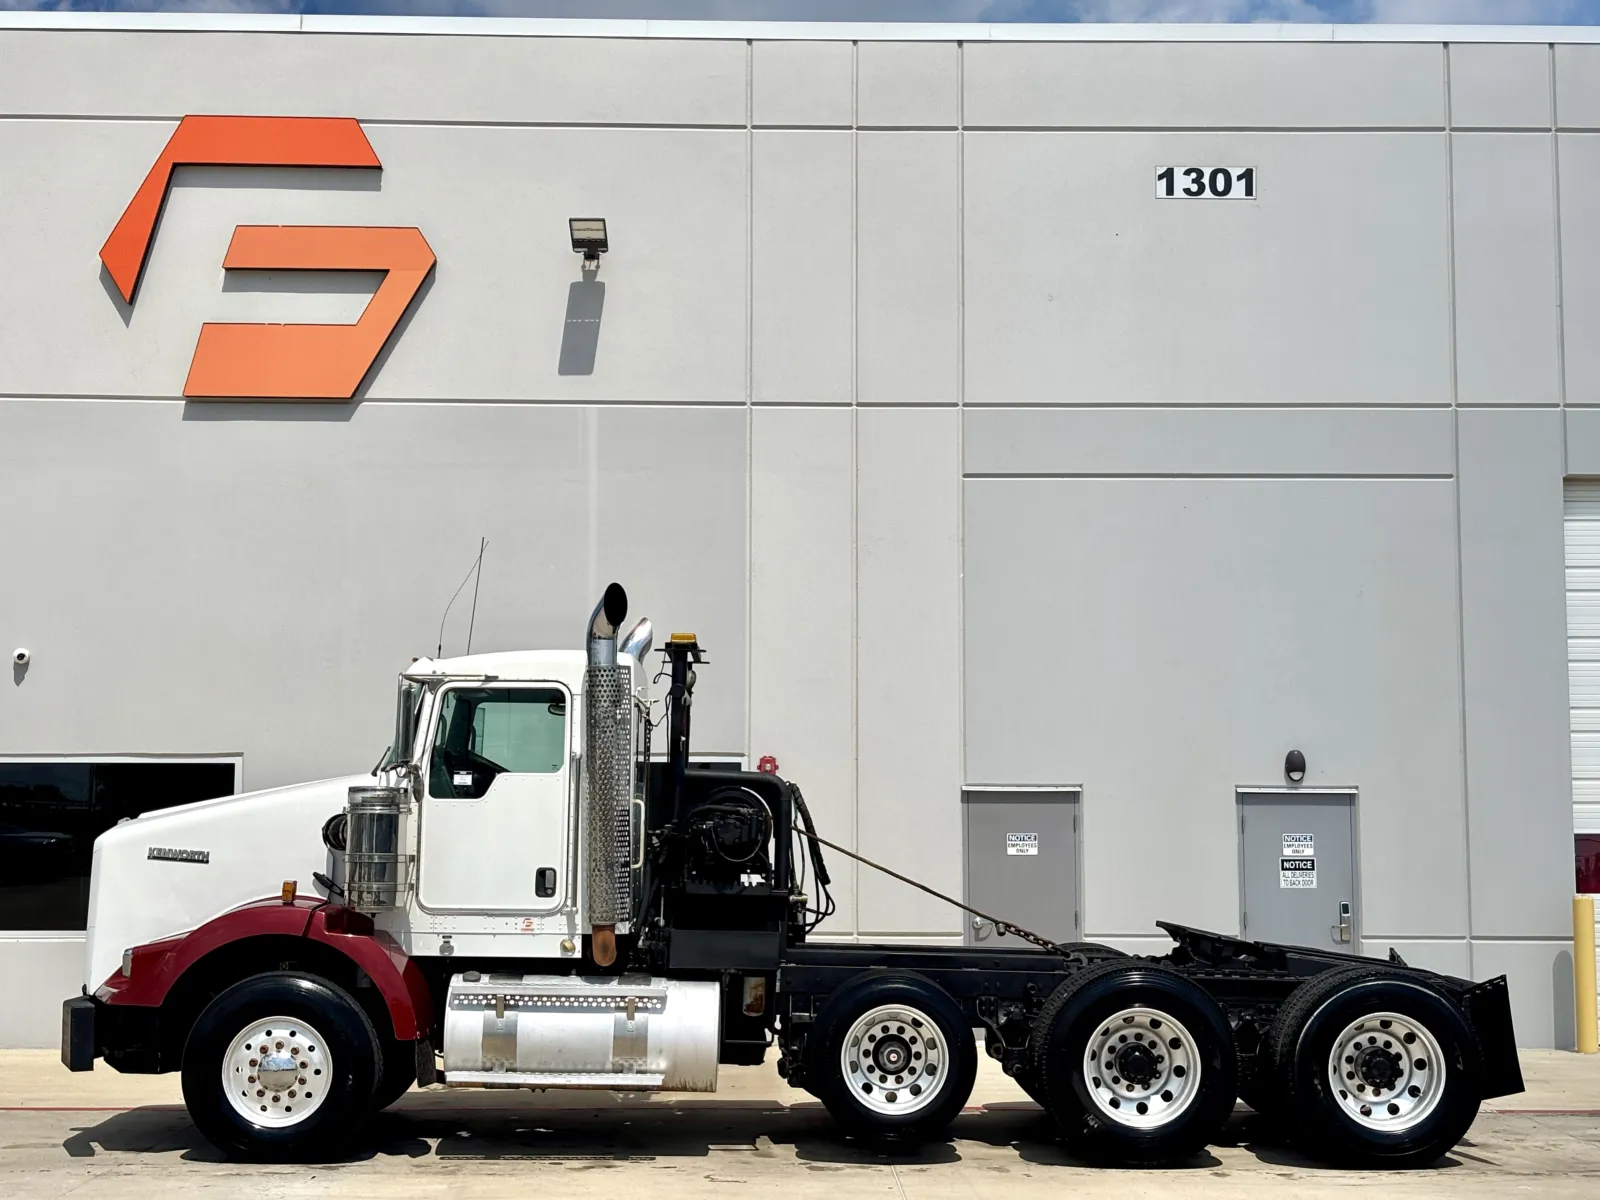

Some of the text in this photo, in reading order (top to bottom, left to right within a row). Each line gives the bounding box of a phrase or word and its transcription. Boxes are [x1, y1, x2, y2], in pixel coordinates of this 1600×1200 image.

[1157, 167, 1254, 197] 1301
[147, 847, 210, 864] KENWORTH
[1283, 861, 1313, 869] NOTICE
[1282, 871, 1314, 879] ALL DELIVERIES
